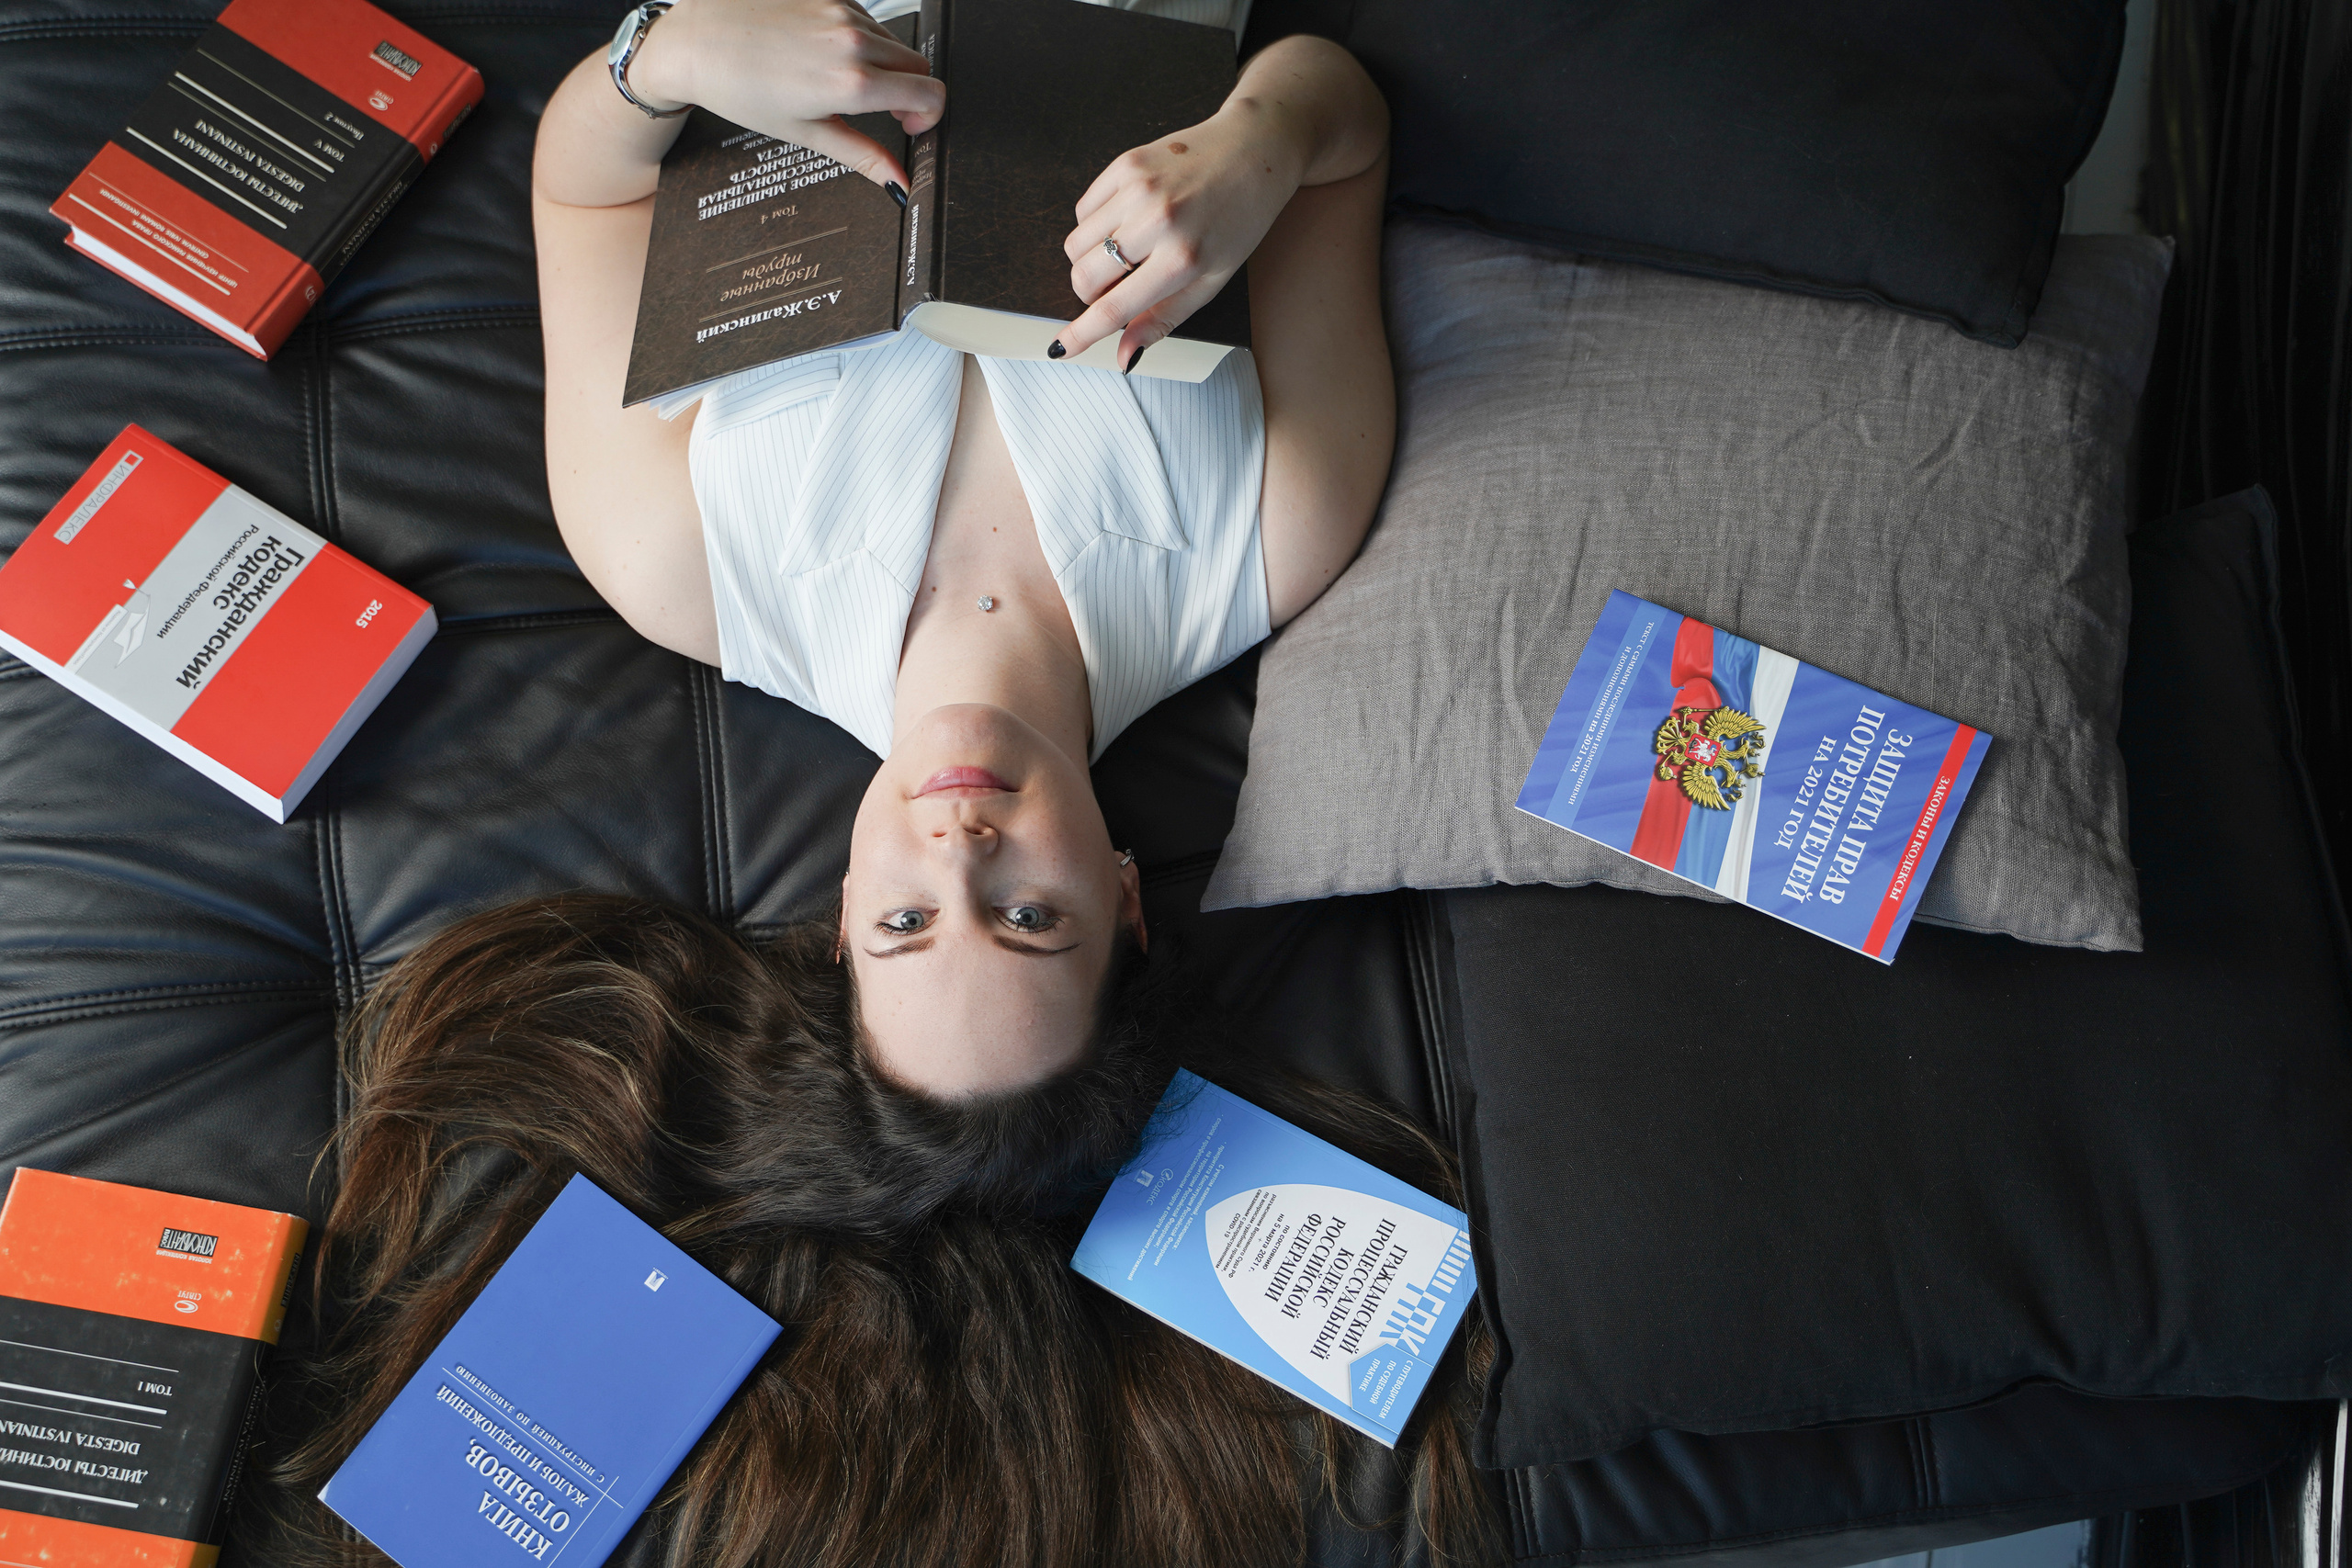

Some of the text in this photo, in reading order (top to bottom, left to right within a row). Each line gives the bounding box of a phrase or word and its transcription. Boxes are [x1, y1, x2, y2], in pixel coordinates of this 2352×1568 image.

[323, 111, 334, 121] 2
[172, 127, 303, 214] ДИГЕСТЫ ЮСТИНИАНА
[194, 118, 305, 192] DIGESTA IVSTINIANI
[313, 138, 345, 163] ТОМ V
[696, 152, 836, 209] ОФЕССИОНАЛЬНАЯ
[697, 159, 854, 220] АВОВОЕ МЫШЛЕНИЕ
[98, 187, 209, 259] CENTRVM IVRIS ROMANI INVESTIGANDI
[760, 204, 798, 224] Том 4
[130, 218, 238, 288] ЦЕНТР ИЗУЧЕНИЯ РИМСКОГО ПРАВА
[741, 252, 802, 280] труды
[719, 262, 821, 302] Избранные
[695, 288, 842, 344] А.Э.Жалинский
[57, 463, 130, 541] ИНФРАЛЕКС
[155, 523, 260, 638] Российской Федерации
[212, 535, 282, 610] кодекс
[175, 546, 305, 690] Гражданский
[355, 598, 382, 628] 2015
[1638, 621, 1655, 645] текст
[1619, 649, 1640, 686] самыми
[1568, 645, 1632, 773] и дополнениями на 2021 год
[1594, 685, 1623, 742] последними
[1566, 741, 1599, 805] изменениями
[1772, 734, 1837, 850] НА 2021 ГОД
[1780, 704, 1885, 904] ПОТРЕБИТЕЛЕЙ
[1818, 728, 1913, 905] ЗАЩИТА ПРАВ
[1888, 775, 1950, 901] ЗАКОНЫ И КОДЕКСЫ
[1207, 1117, 1222, 1136] споров
[1178, 1138, 1209, 1189] профессиональном
[1188, 1156, 1208, 1188] территории
[1204, 1149, 1212, 1158] на
[1206, 1168, 1221, 1188] учетом
[1152, 1144, 1225, 1267] приоритета Конституции Российской Федерации
[1154, 1210, 1169, 1229] спорте
[1167, 1187, 1182, 1206] спорте
[1170, 1186, 1193, 1218] Российской
[1189, 1186, 1210, 1216] изменений,
[1243, 1188, 1262, 1217] связанным
[1275, 1213, 1284, 1223] на
[1143, 1227, 1159, 1249] высших
[1170, 1216, 1193, 1251] касающихся:
[1215, 1219, 1244, 1269] распространением
[1220, 1190, 1270, 1272] по вопросам судебной практики,
[1223, 1212, 1241, 1238] COVID-19
[1227, 1192, 1277, 1279] разъяснения Верховного Суда РФ
[1261, 1227, 1276, 1249] марта
[1261, 1224, 1290, 1270] по состоянию
[1125, 1247, 1148, 1281] достижений
[1252, 1248, 1266, 1267] 2021
[1263, 1213, 1322, 1303] ФЕДЕРАЦИИ
[1280, 1215, 1346, 1319] РОССИЙСКОЙ
[1312, 1247, 1354, 1308] КОДЕКС
[176, 1289, 202, 1301] СТАТУТ
[1309, 1217, 1396, 1359] ПРОЦЕССУАЛЬНЫЙ
[1338, 1243, 1408, 1354] ГРАЖДАНСКИЙ
[1376, 1280, 1447, 1359] ГПК
[136, 1380, 173, 1396] ТОМ I
[1357, 1358, 1381, 1392] ПРАКТИКЕ
[1368, 1359, 1396, 1404] ПО СУДЕБНОЙ
[1377, 1363, 1411, 1419] ПУТЕВОДИТЕЛЕМ
[74, 1431, 141, 1455] DIGESTA
[435, 1381, 590, 1507] ЖАЛОБ И ПРЕДЛОЖЕНИЙ
[455, 1363, 605, 1483] С ИНСТРУКЦИЕЙ ПО ЗАПОЛНЕНИЮ
[73, 1460, 149, 1483] ДИГЕСТЫ
[464, 1436, 571, 1532] ОТЗЫВОВ,
[477, 1488, 553, 1561] КНИГА
